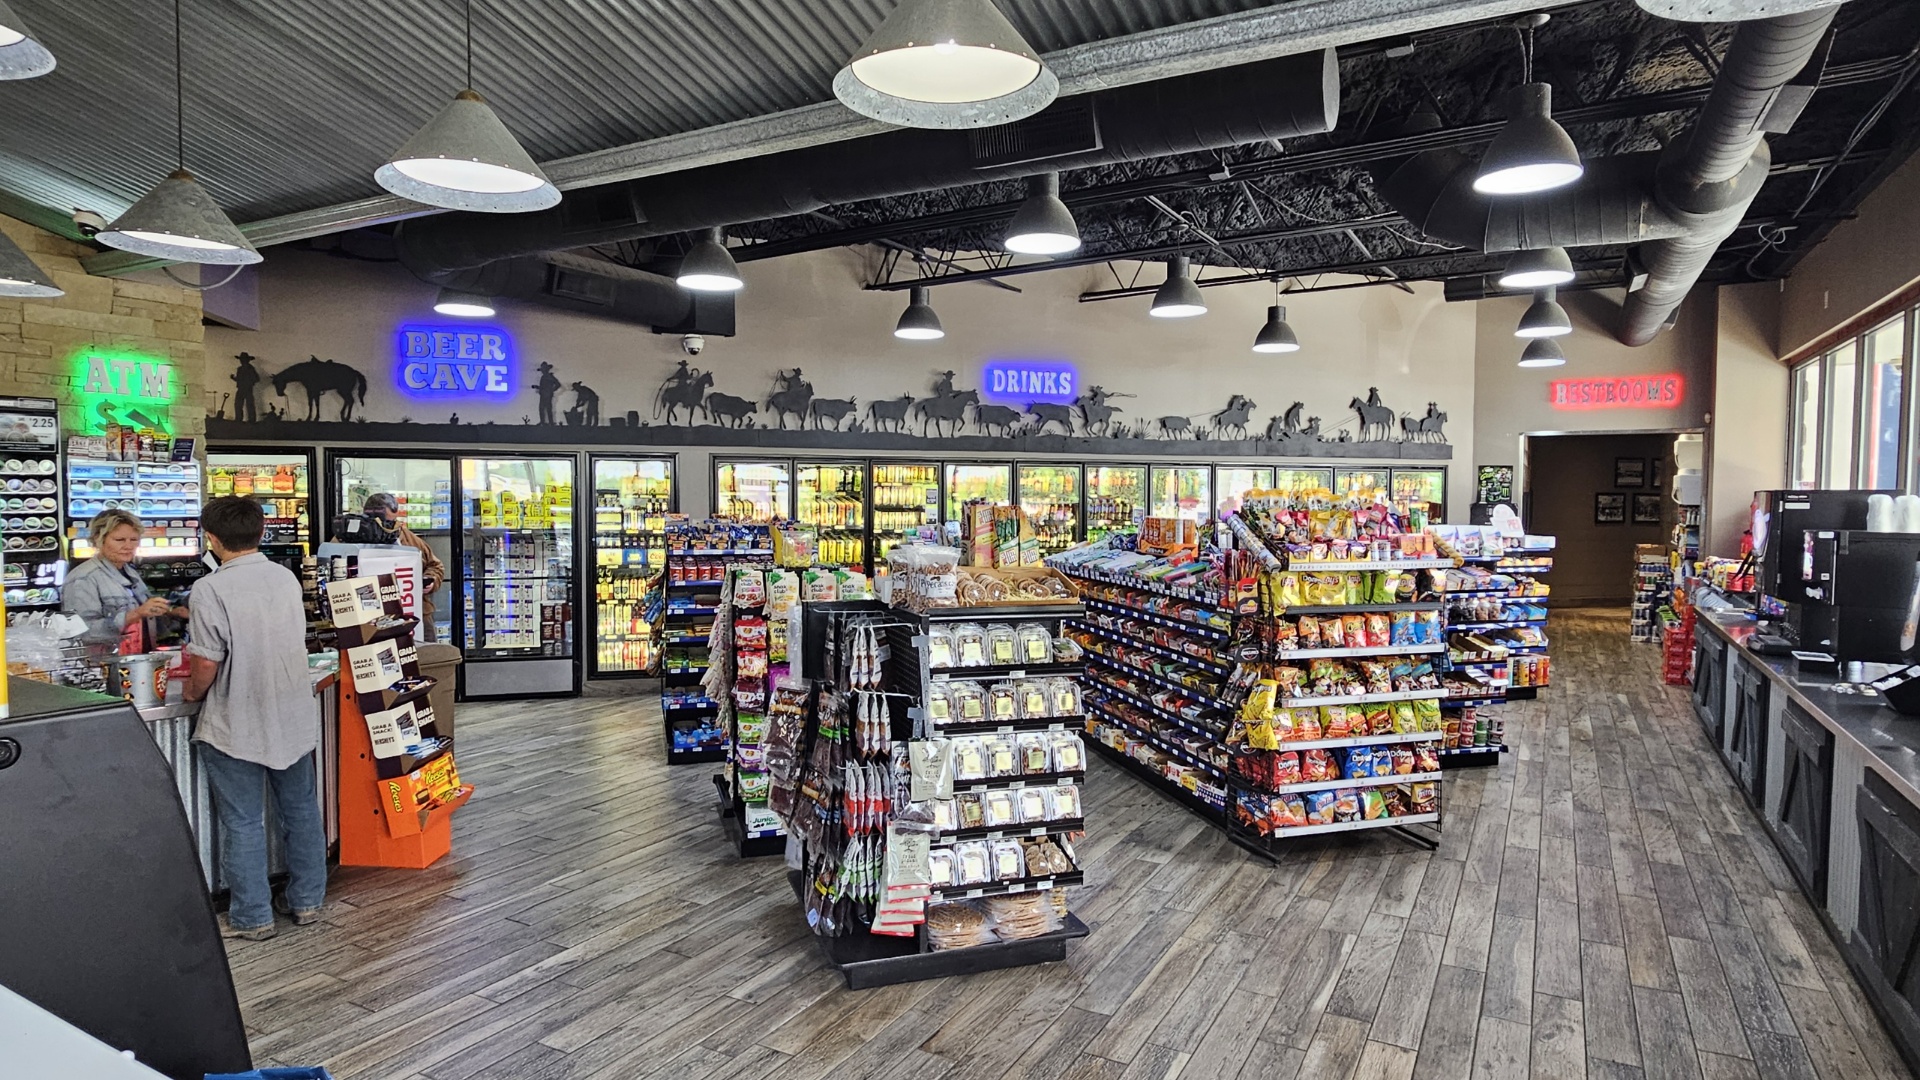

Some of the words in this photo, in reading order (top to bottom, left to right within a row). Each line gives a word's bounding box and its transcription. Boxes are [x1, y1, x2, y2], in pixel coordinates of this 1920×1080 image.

[405, 331, 506, 361] BEER
[84, 357, 171, 398] ATM
[404, 363, 508, 392] CAVE
[993, 369, 1072, 395] DRINKS
[1556, 379, 1677, 404] RESTROOMS
[380, 586, 395, 594] GRAB
[395, 567, 414, 608] Bull
[354, 662, 374, 670] SNACK!
[400, 653, 418, 665] SNACK!
[373, 727, 393, 735] SNACK!
[425, 767, 445, 784] Reese's
[388, 781, 404, 813] Reese's
